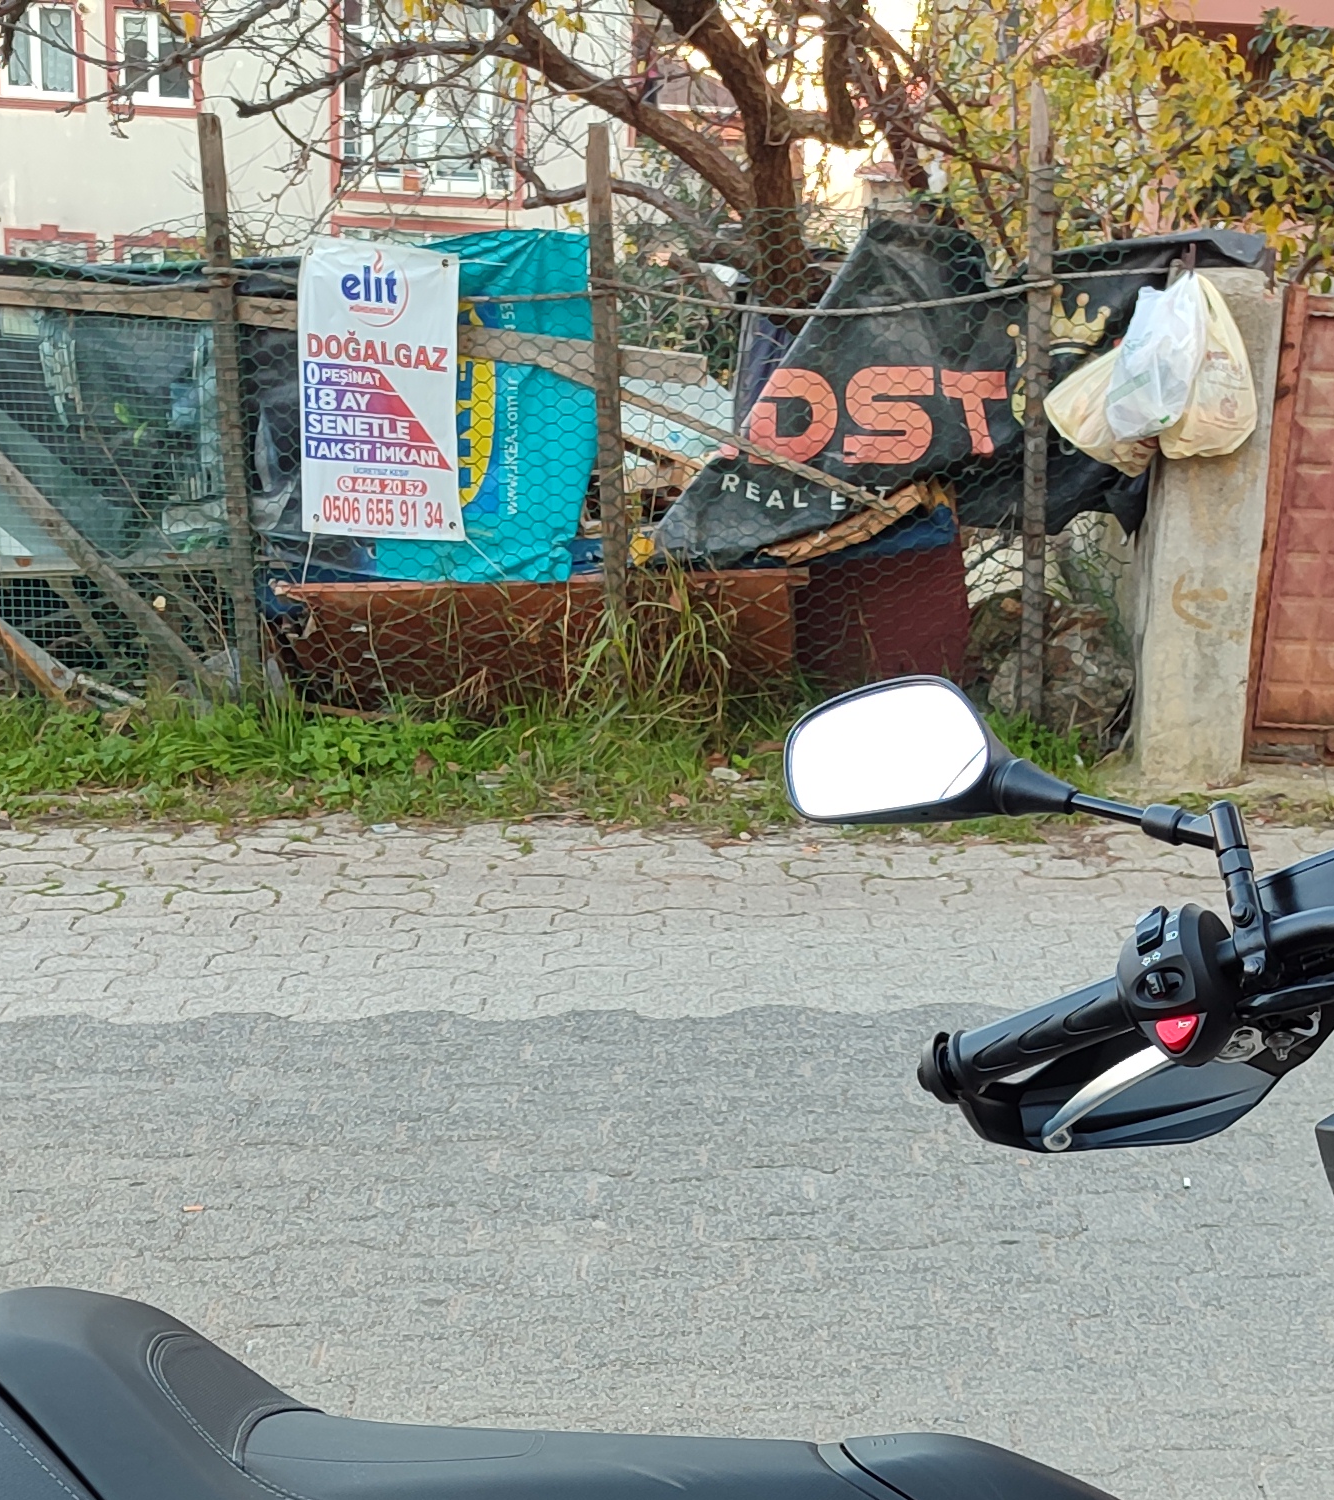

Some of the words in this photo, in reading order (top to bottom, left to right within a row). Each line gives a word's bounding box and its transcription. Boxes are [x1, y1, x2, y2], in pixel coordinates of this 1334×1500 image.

[341, 264, 398, 304] elit
[307, 330, 448, 373] DOĞALGAZ
[306, 363, 320, 385] 0
[307, 388, 338, 410] 18
[340, 393, 371, 411] AY
[307, 415, 411, 441] SENETLE
[308, 440, 373, 461] TAKSİT
[375, 443, 440, 467] İMKANI
[354, 479, 381, 493] 444
[384, 481, 402, 494] 20
[405, 482, 423, 495] 52
[721, 473, 809, 510] REAL
[322, 495, 361, 524] 0506
[366, 497, 394, 527] 655
[399, 500, 417, 528] 91
[424, 501, 444, 529] 34
